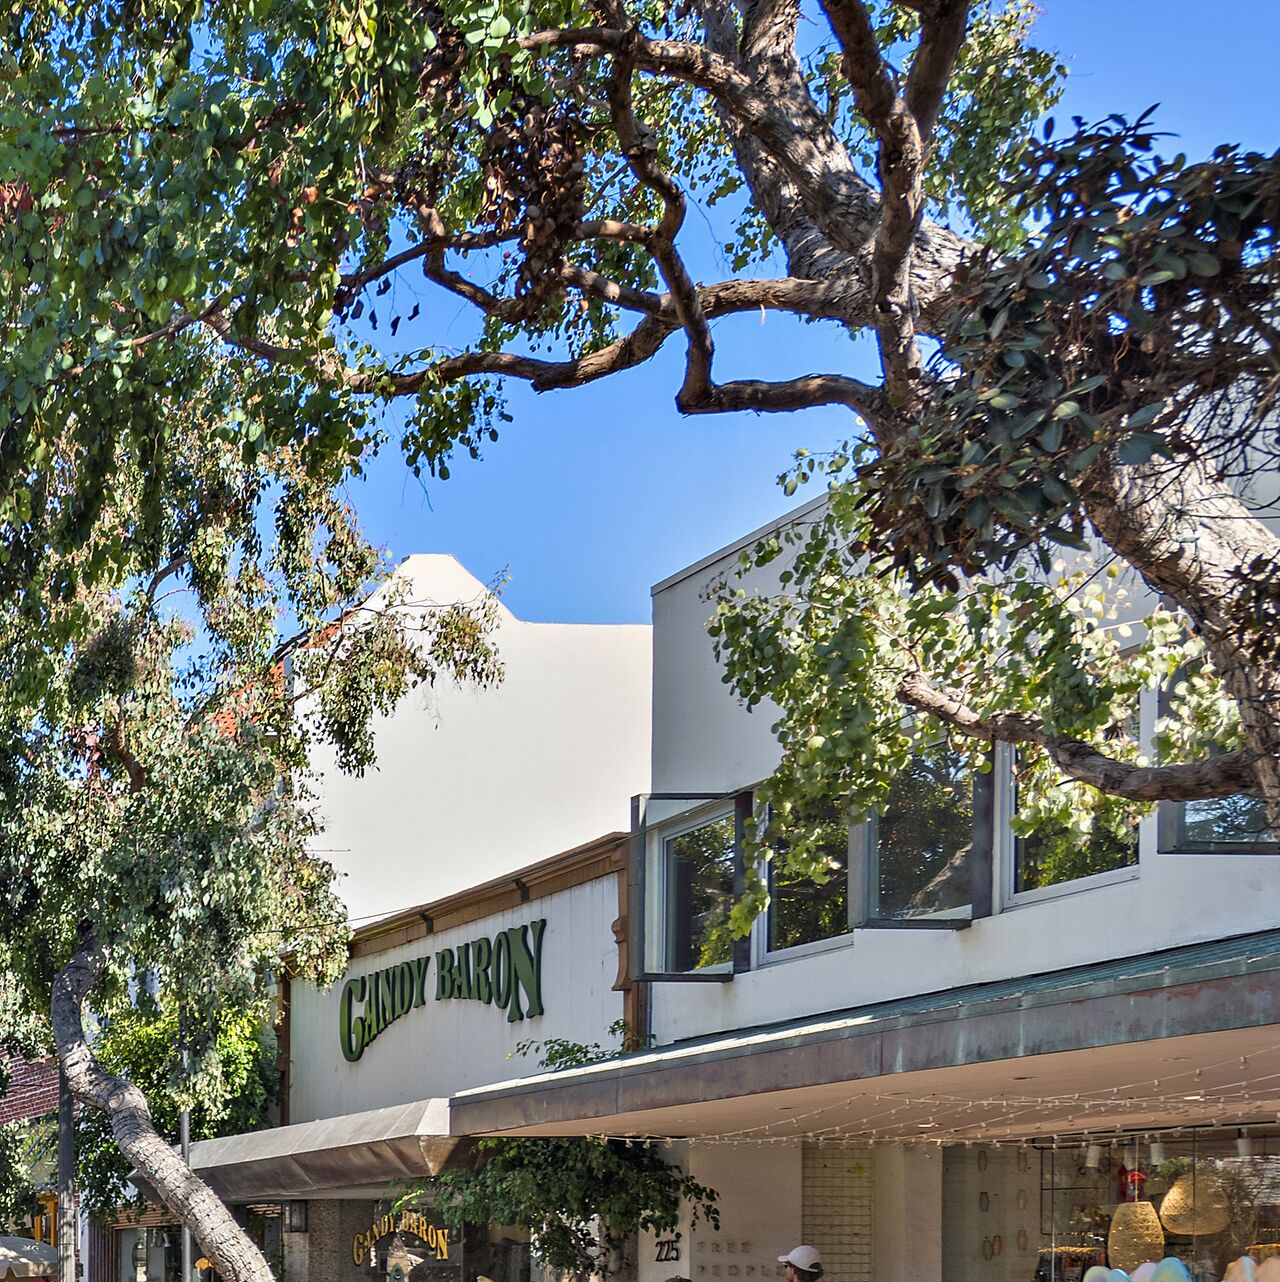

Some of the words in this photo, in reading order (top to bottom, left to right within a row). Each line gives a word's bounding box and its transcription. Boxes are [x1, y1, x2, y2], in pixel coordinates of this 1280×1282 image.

[340, 956, 430, 1062] CANDY
[435, 919, 546, 1022] BARON
[402, 1209, 448, 1259] BARON
[655, 1240, 679, 1262] 225
[697, 1241, 752, 1253] FREE
[697, 1264, 785, 1277] PEOPLE
